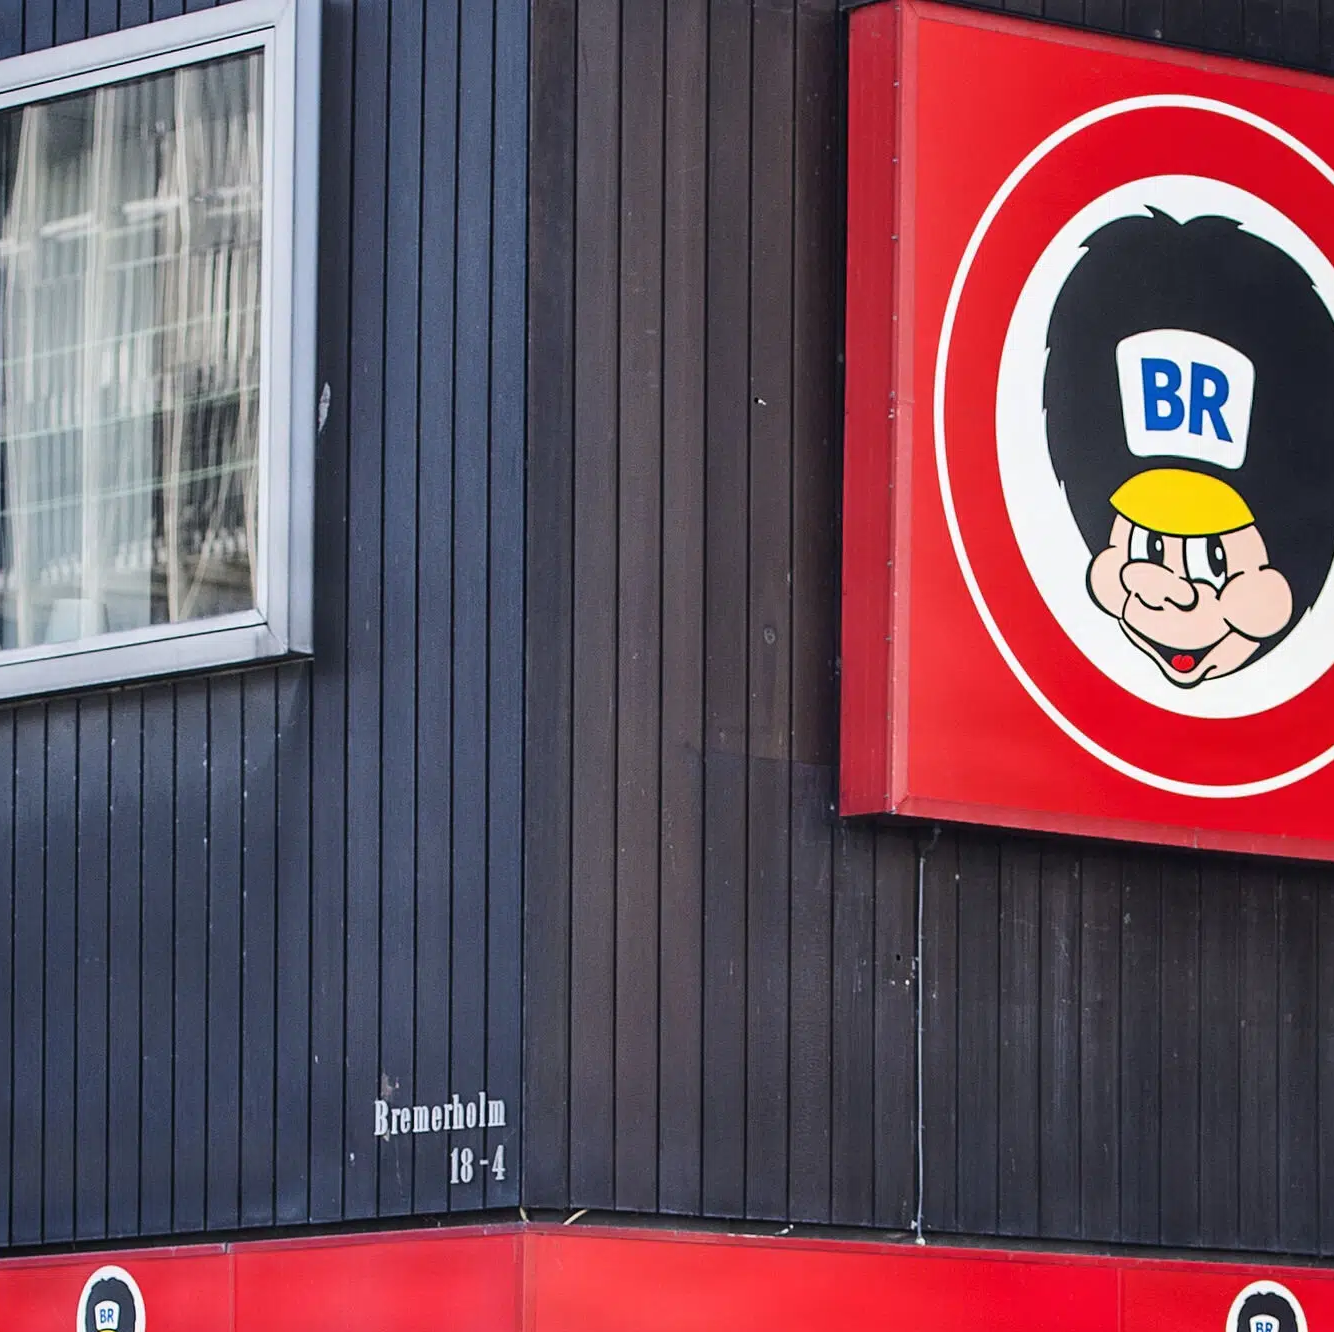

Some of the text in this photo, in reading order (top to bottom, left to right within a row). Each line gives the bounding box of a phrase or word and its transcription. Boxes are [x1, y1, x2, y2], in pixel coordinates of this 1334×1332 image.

[1141, 357, 1234, 443] BR
[374, 1091, 506, 1136] Bremerholm
[100, 1308, 114, 1324] BR
